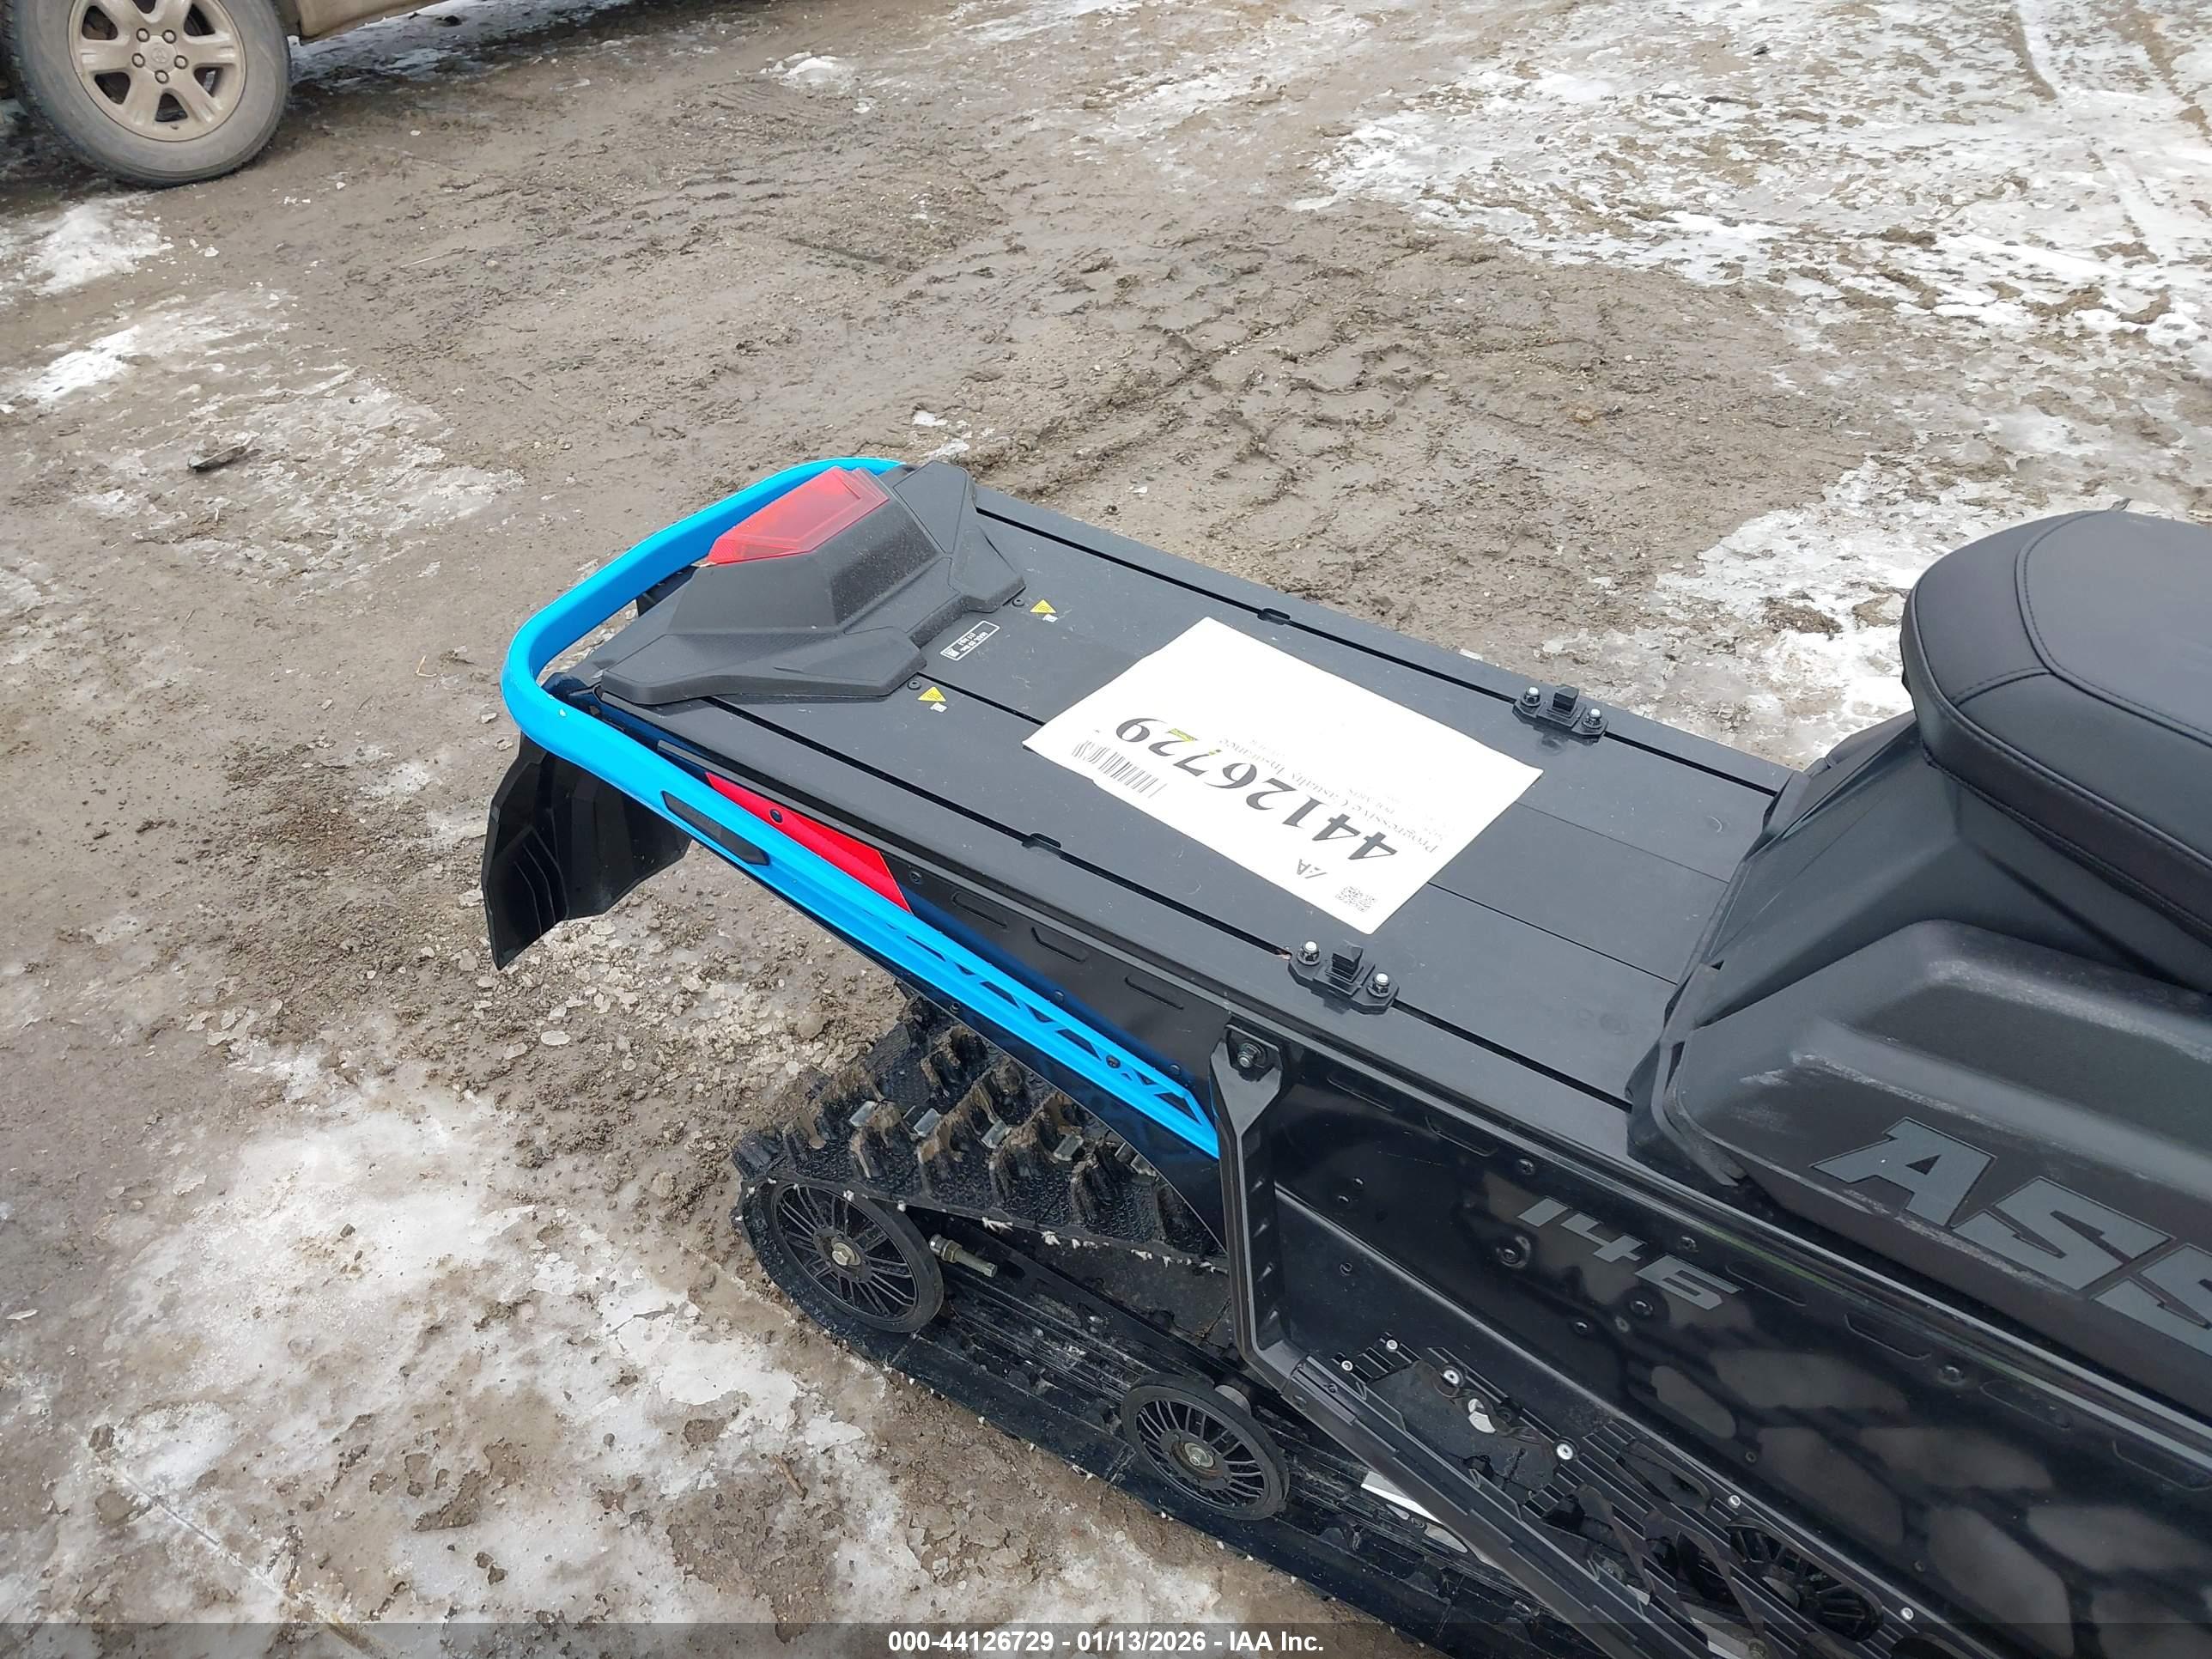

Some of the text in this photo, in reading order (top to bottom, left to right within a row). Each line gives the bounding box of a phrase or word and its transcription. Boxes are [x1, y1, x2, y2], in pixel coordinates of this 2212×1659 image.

[1218, 737, 1286, 775] Insurance
[1115, 716, 1398, 861] 44126729
[1291, 772, 1349, 807] Casualty
[1352, 805, 1438, 854] Progressive
